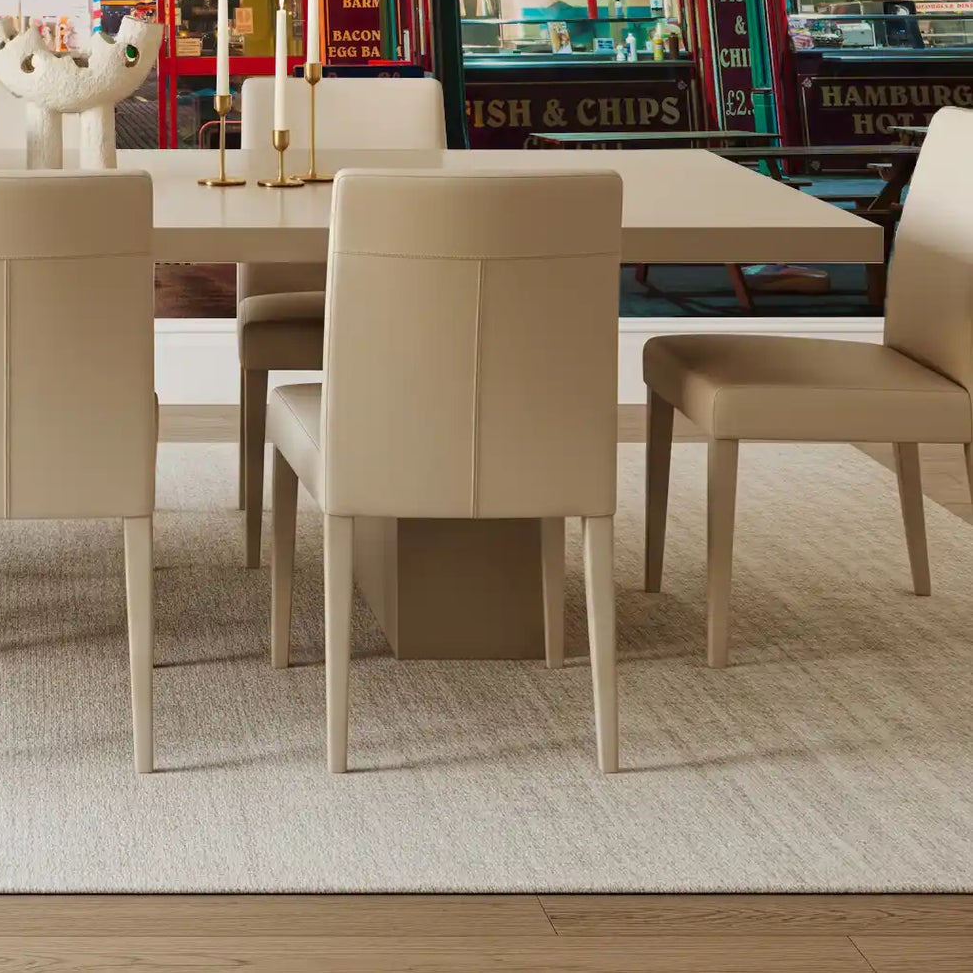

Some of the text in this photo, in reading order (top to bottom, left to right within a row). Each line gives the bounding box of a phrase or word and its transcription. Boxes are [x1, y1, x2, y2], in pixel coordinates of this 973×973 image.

[735, 15, 747, 35] &
[333, 30, 381, 41] BACON
[328, 47, 357, 58] EGG
[720, 48, 752, 68] CHI
[542, 98, 568, 127] &
[577, 96, 680, 126] CHIPS
[726, 90, 754, 116] £2.
